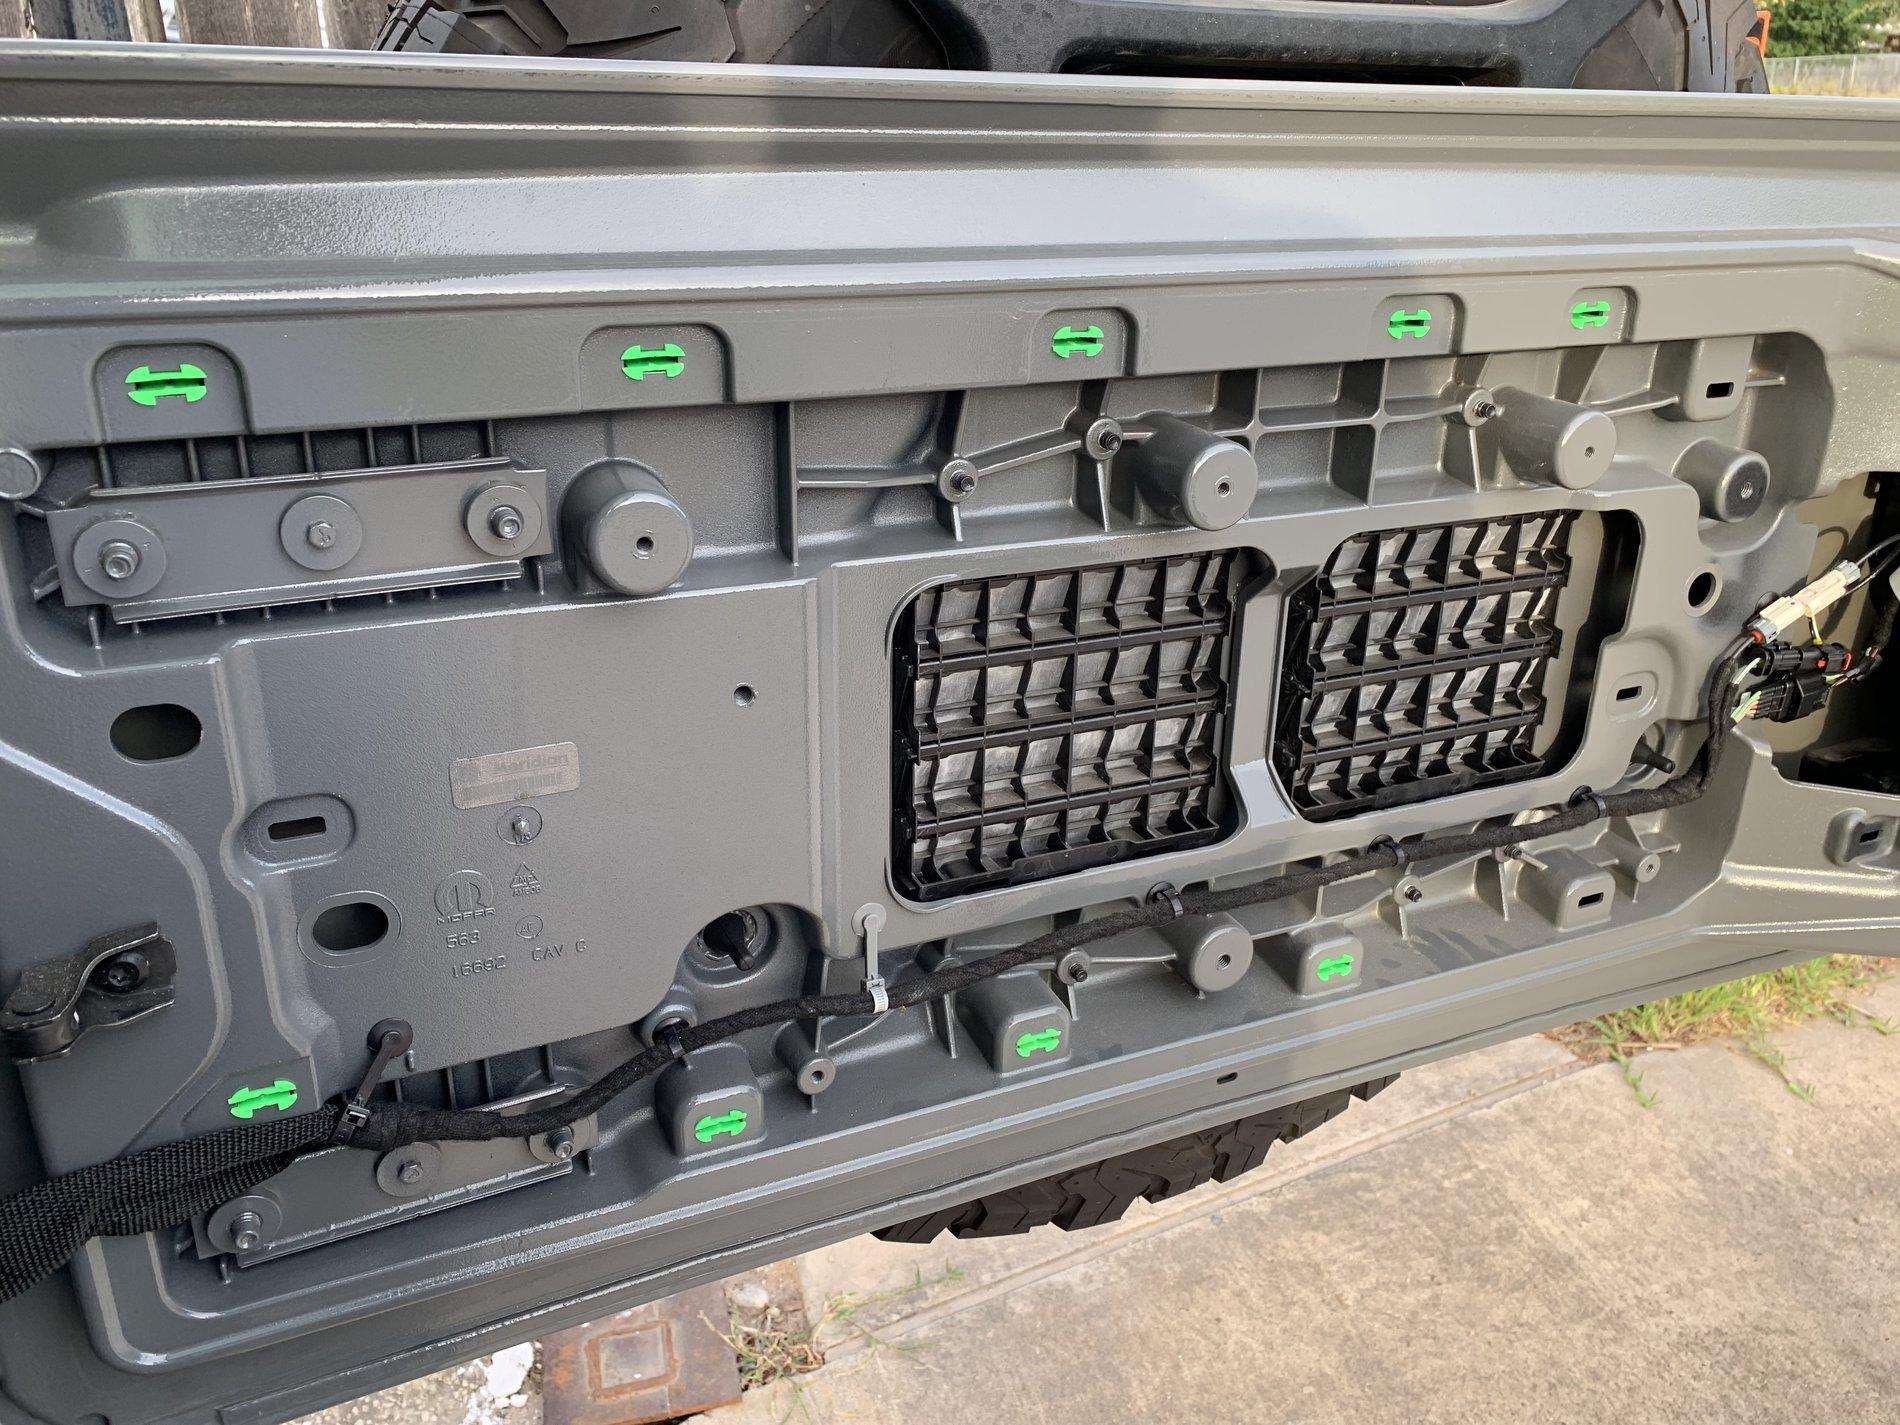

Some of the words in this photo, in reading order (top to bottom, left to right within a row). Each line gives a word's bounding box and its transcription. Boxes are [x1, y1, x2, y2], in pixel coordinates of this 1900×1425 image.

[436, 907, 496, 925] MOPAR
[446, 930, 480, 948] 563
[532, 944, 563, 961] CAV
